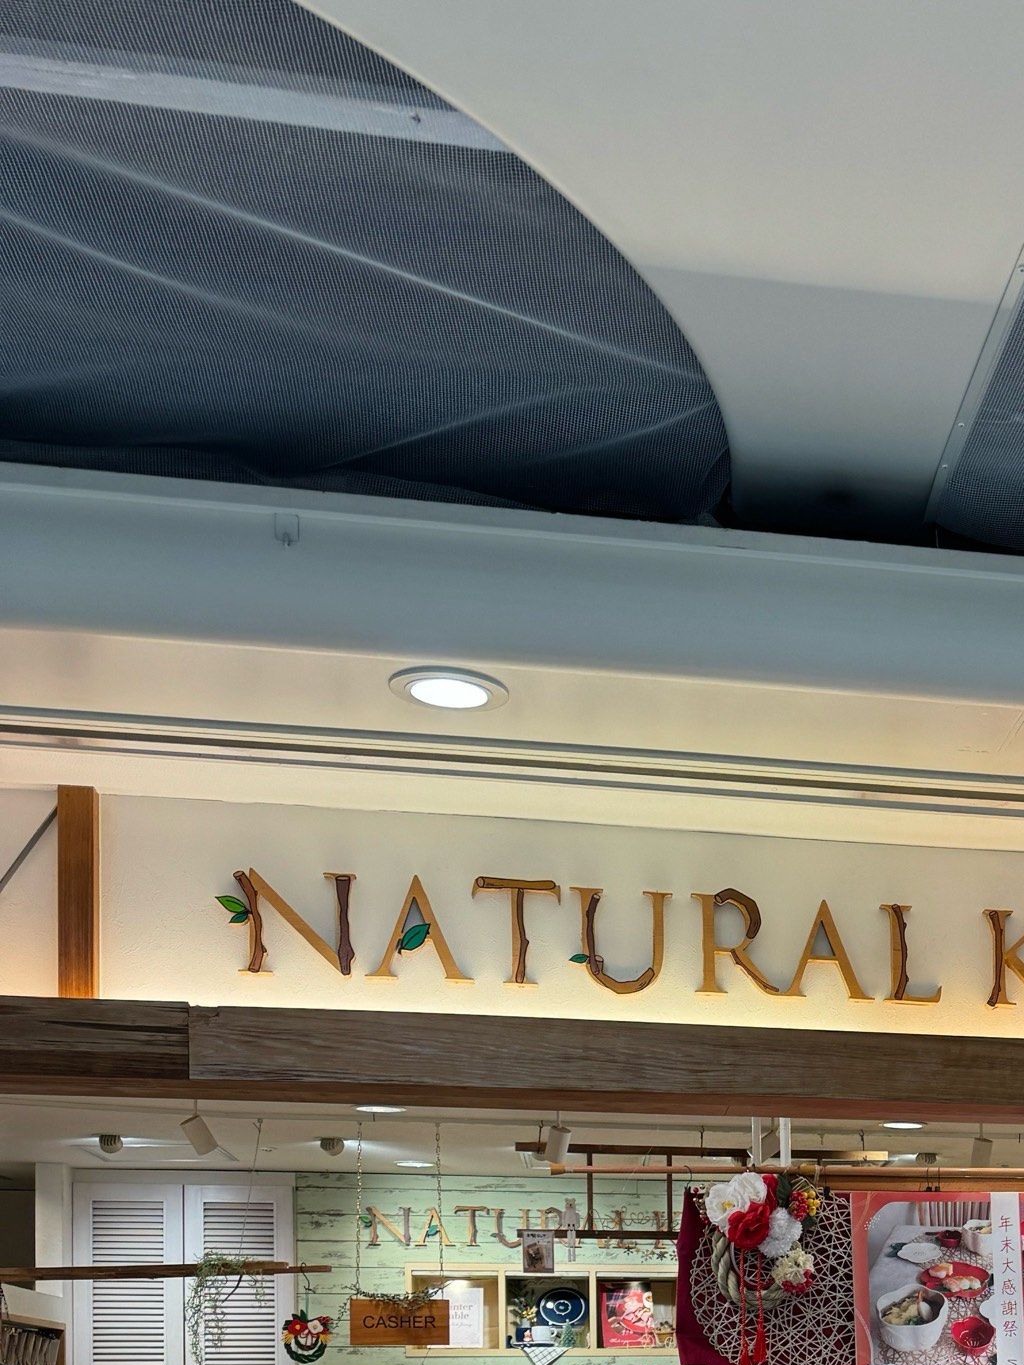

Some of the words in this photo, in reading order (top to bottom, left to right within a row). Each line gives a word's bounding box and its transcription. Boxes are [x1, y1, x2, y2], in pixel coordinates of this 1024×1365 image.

[232, 866, 942, 1005] NATURAL
[450, 1303, 474, 1311] nter
[998, 1214, 1019, 1338] 年末大感謝祭
[362, 1315, 437, 1329] CASHER
